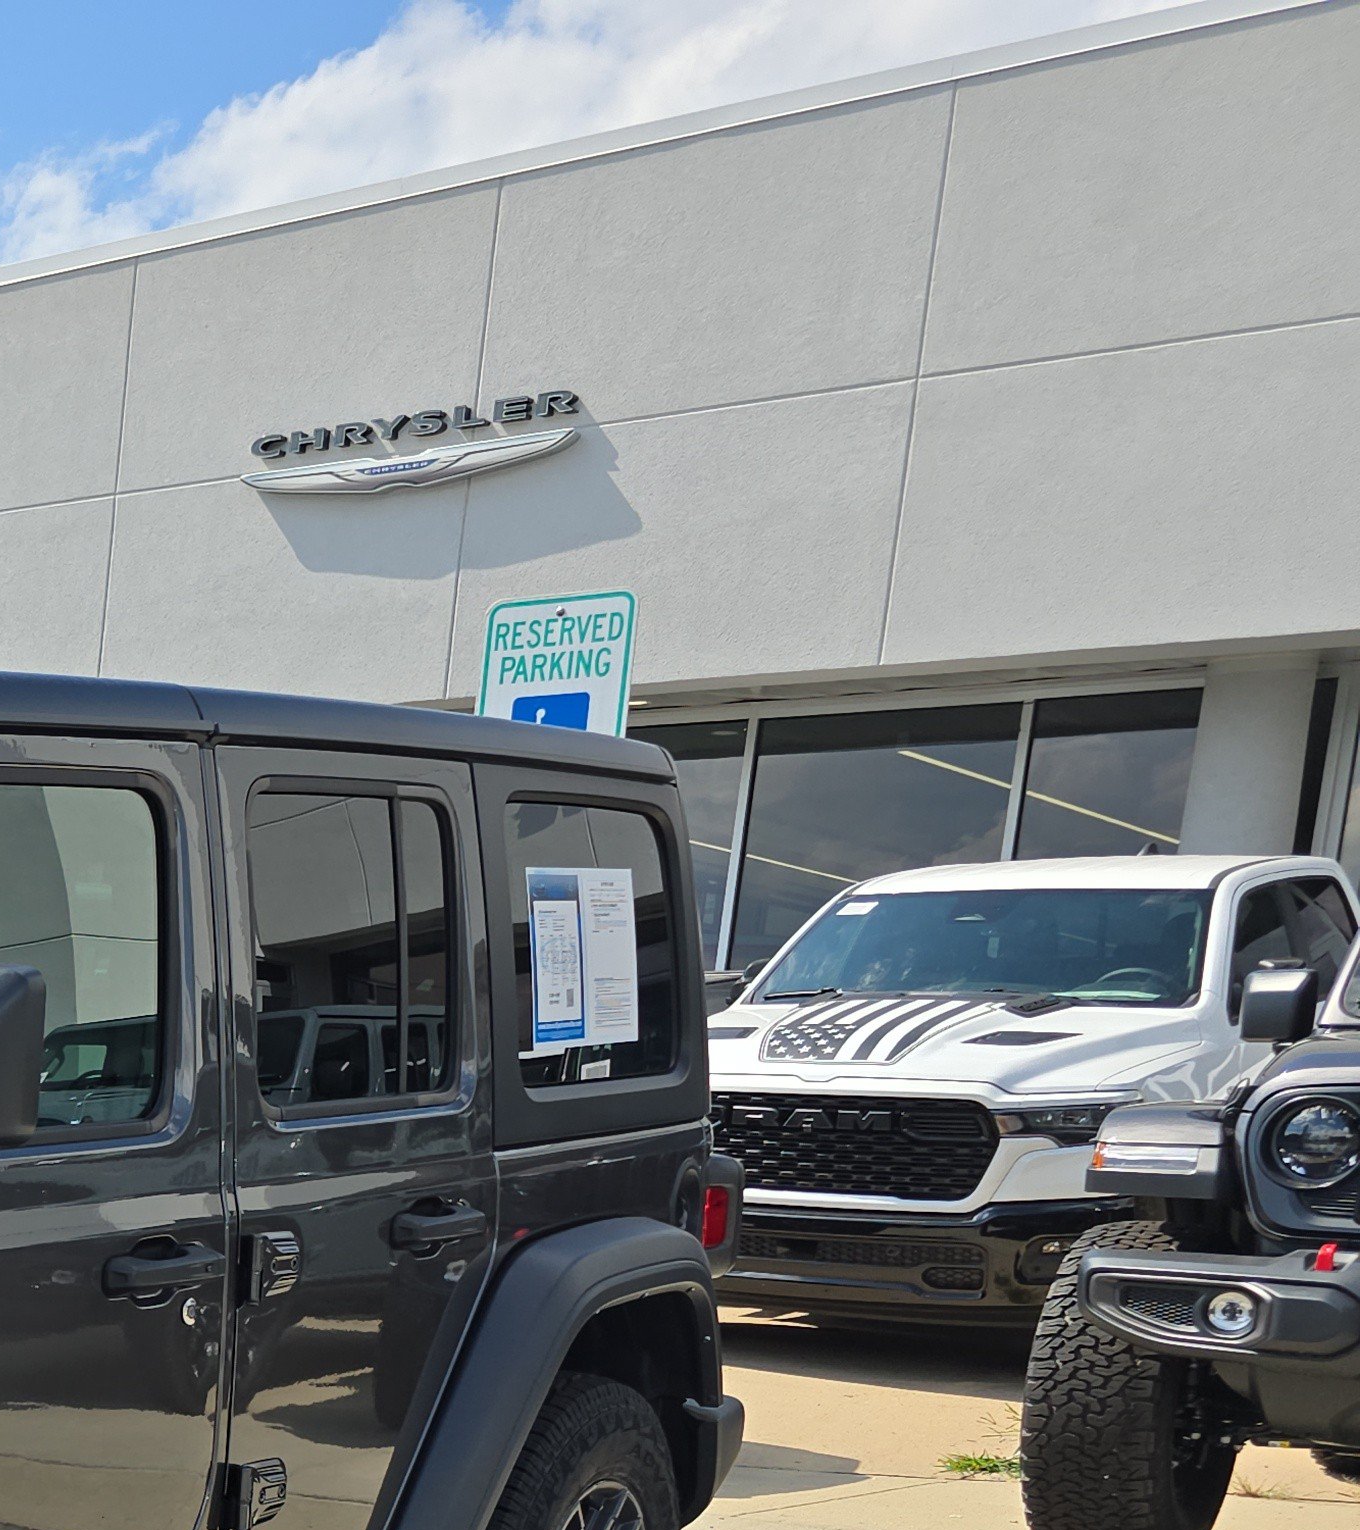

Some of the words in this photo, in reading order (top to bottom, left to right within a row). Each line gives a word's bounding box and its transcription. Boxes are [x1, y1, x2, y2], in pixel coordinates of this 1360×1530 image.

[250, 389, 581, 459] CHRYSLER
[493, 611, 625, 651] RESERVED
[499, 647, 612, 685] PARKING
[730, 1105, 894, 1131] RAM
